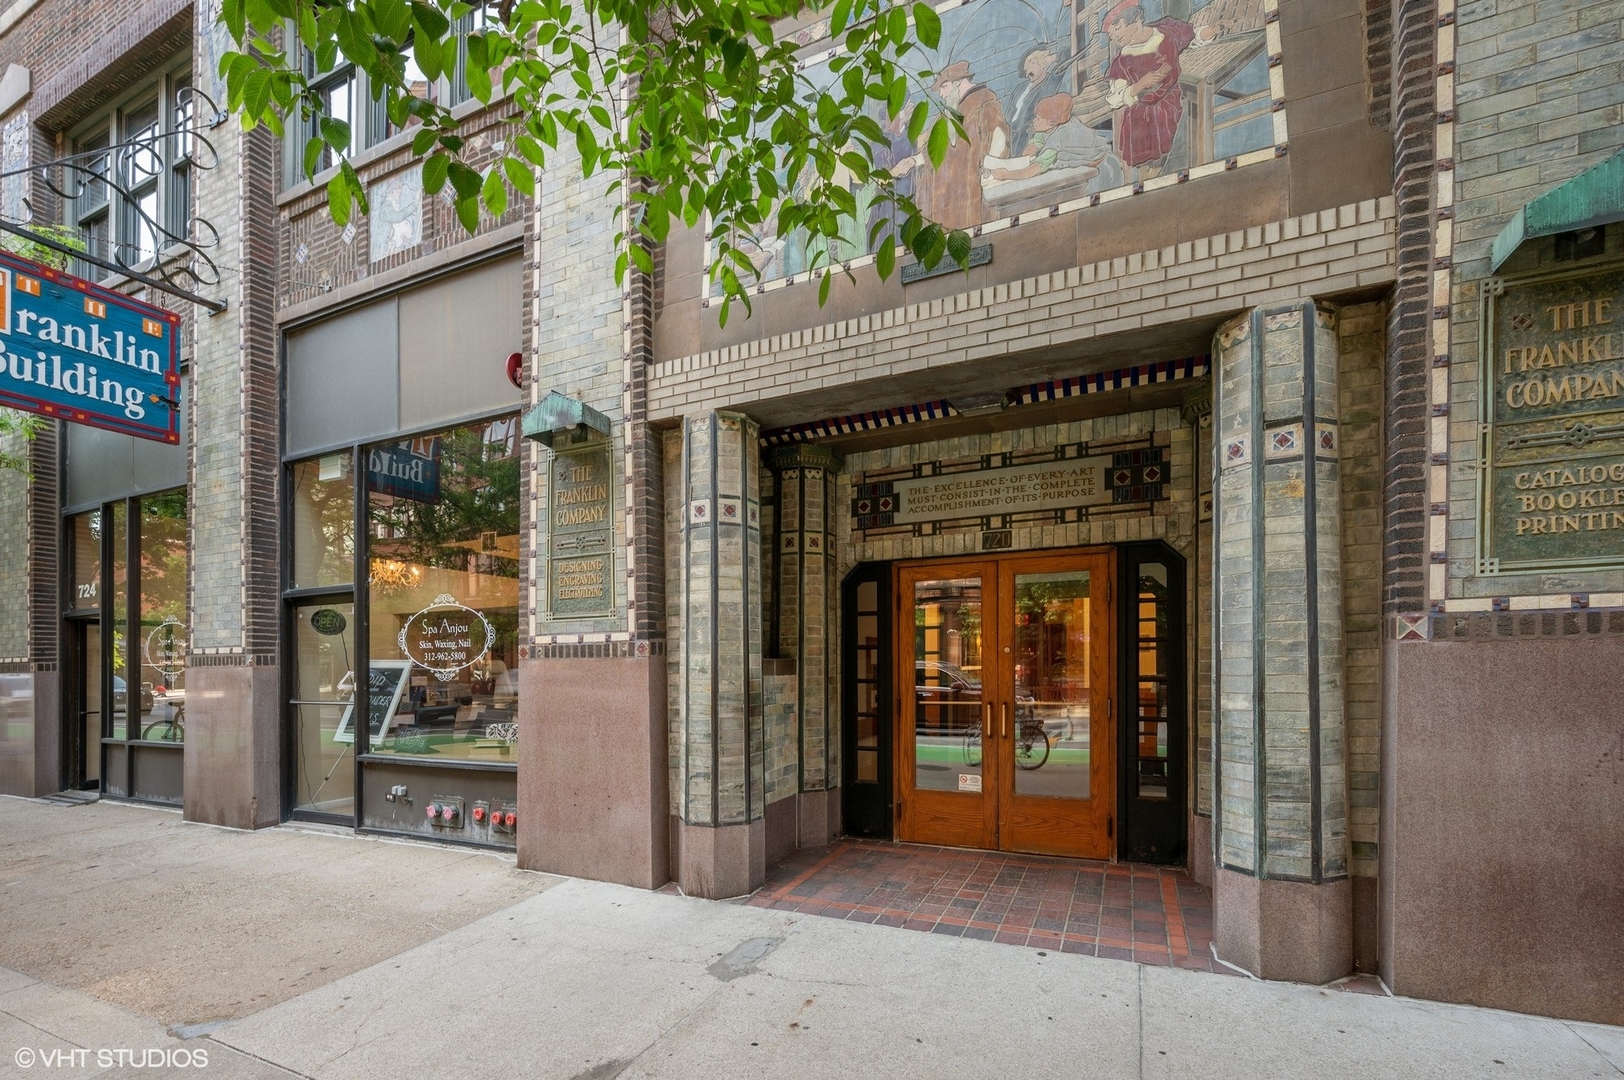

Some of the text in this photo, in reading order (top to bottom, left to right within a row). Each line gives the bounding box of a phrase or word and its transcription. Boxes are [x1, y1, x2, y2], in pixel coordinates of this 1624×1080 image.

[1547, 298, 1613, 331] THE
[0, 294, 163, 376] ranklin
[1504, 332, 1624, 374] FRANKL
[1506, 369, 1624, 408] COMPAN
[570, 465, 593, 483] THE
[908, 467, 1095, 495] THE EXCELLENCE OF EVERY ART
[1515, 463, 1624, 490] CATALOG
[555, 484, 607, 506] FRANKLIN
[907, 477, 1095, 505] MUST CONSIST IN THE COMPLETE
[907, 487, 1095, 514] ACCOMPLISHMENT OF ITS PURPOSE
[1515, 486, 1624, 513] BOOKLE
[556, 505, 607, 526] COMPANY
[1515, 511, 1624, 536] PRINTIN
[984, 532, 1010, 548] 720
[558, 560, 603, 574] DESIGNING
[78, 583, 97, 598] 724
[558, 573, 603, 587] ENGRAVING
[314, 615, 340, 628] OPEN
[422, 618, 468, 637] Spa Anjou
[419, 638, 472, 650] Skin, Waxing, Nail
[424, 651, 467, 661] 312-962-5800
